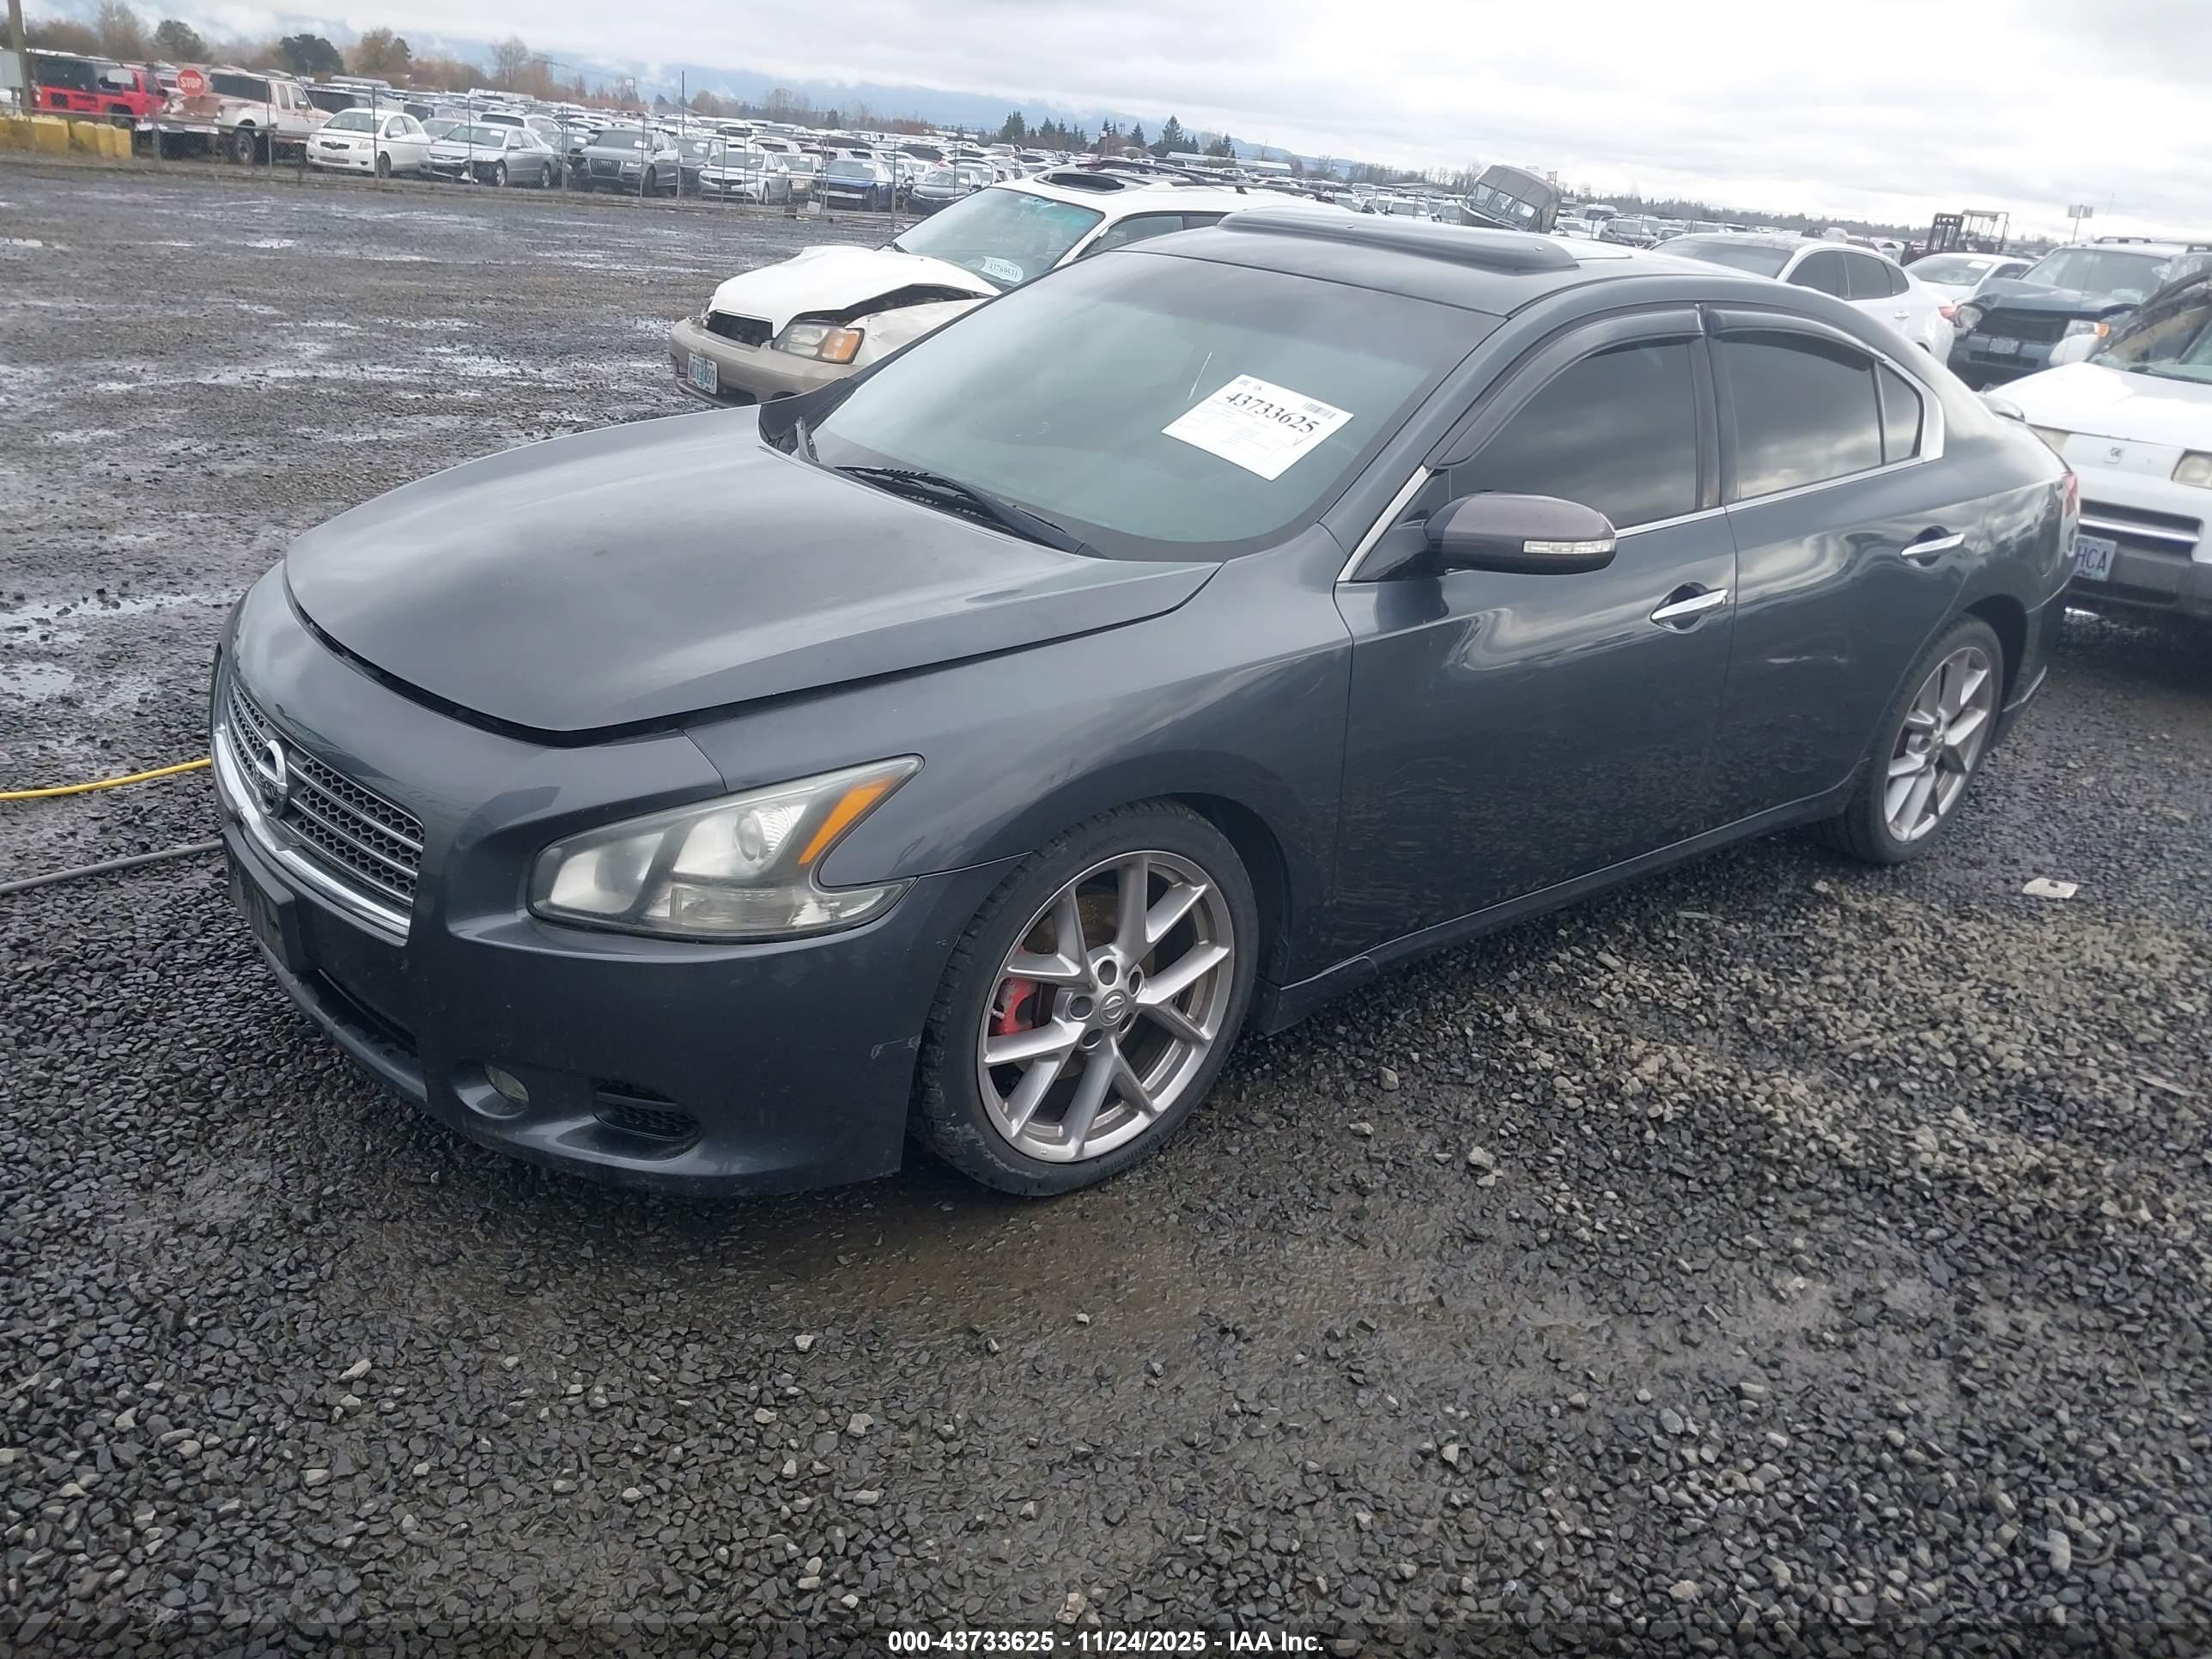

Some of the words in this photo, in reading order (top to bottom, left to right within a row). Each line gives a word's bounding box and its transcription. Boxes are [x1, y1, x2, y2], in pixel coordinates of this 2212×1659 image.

[179, 76, 203, 90] STOP
[1225, 392, 1321, 434] 43733625
[2075, 544, 2107, 572] HCA
